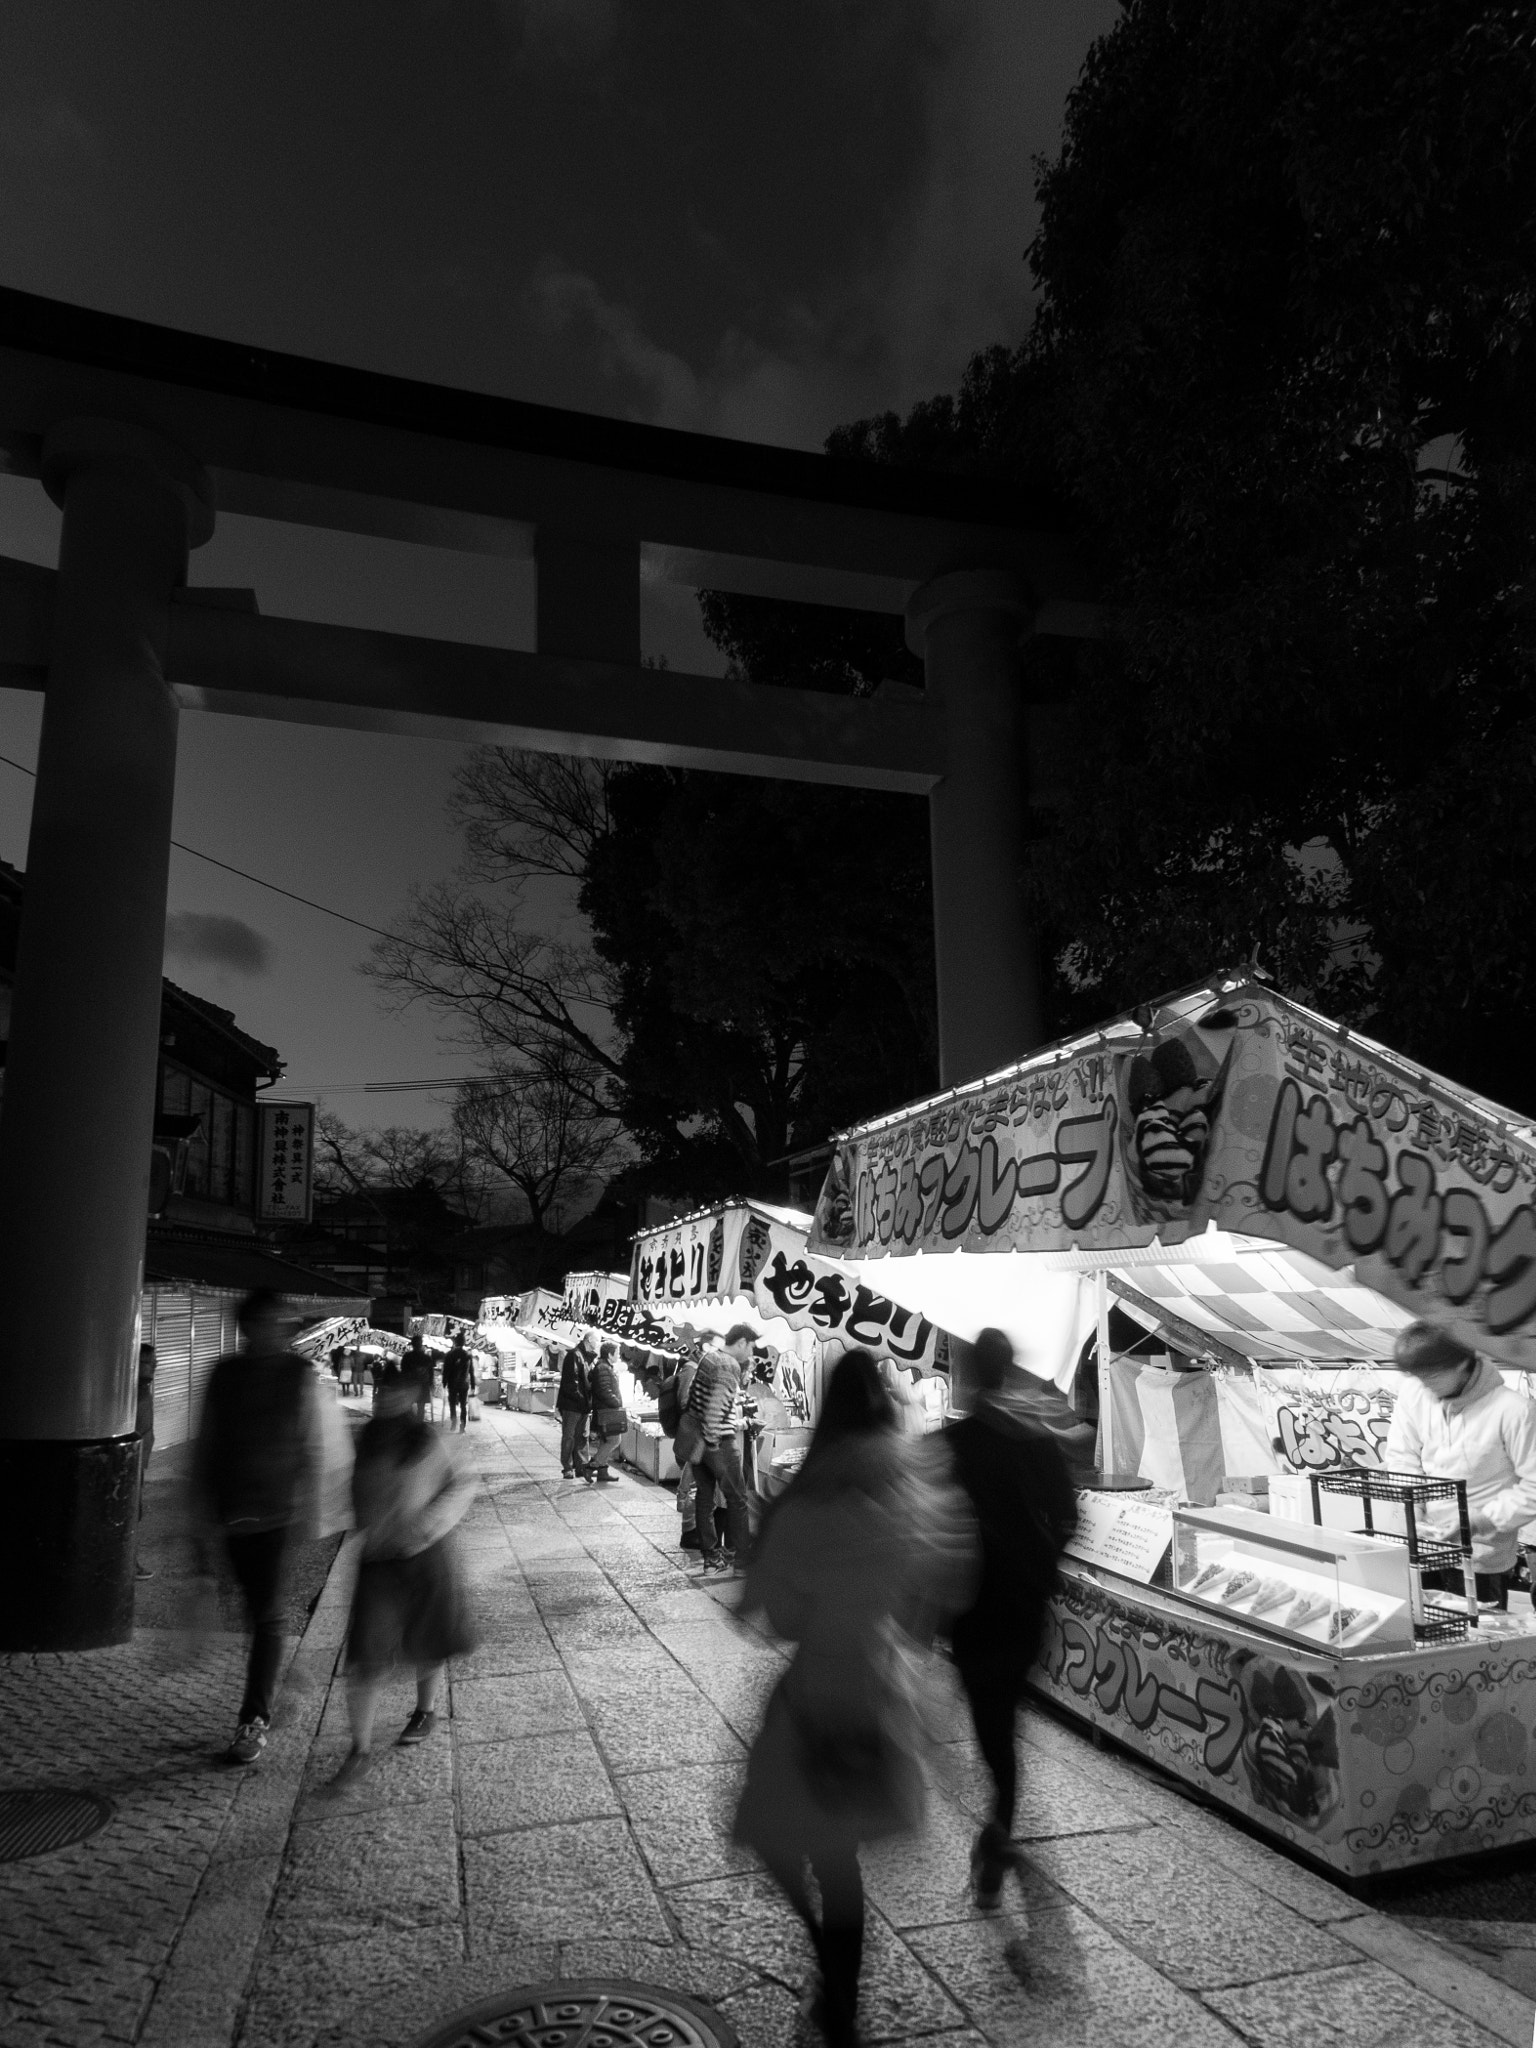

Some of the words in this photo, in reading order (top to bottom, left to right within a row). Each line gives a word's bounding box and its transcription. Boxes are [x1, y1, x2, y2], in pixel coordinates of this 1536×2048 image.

[858, 1093, 1118, 1247] はちみつクレープ
[640, 1241, 705, 1301] やきとり
[763, 1251, 934, 1361] やきとり
